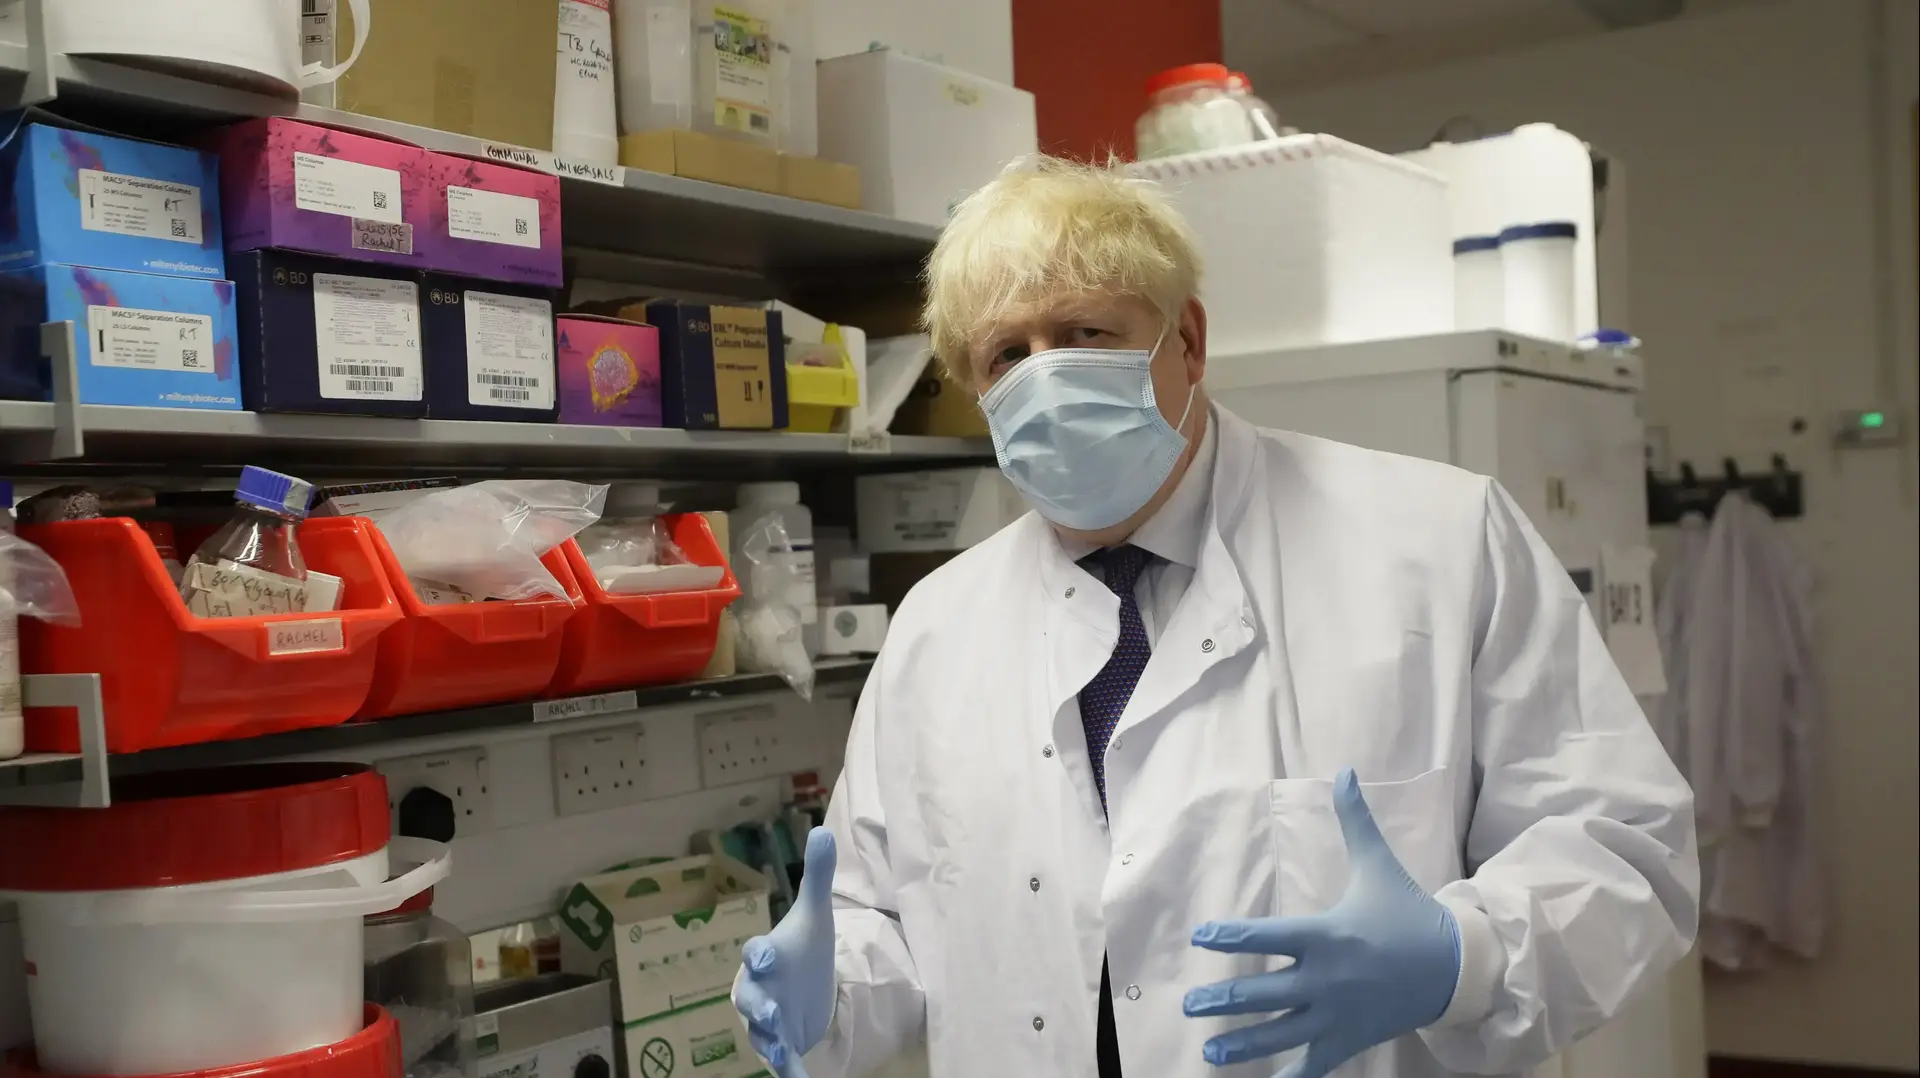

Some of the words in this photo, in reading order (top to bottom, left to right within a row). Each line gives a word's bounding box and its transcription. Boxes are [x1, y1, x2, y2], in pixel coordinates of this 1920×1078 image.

[486, 145, 539, 165] COMMUNAL
[553, 158, 615, 181] UNIVERSALS
[128, 180, 163, 191] Separation
[164, 185, 192, 195] Columns
[164, 198, 183, 213] RT
[289, 271, 308, 285] BD
[444, 291, 459, 304] BD
[137, 312, 174, 323] Separation
[174, 315, 203, 325] Columns
[179, 327, 198, 341] RT
[714, 337, 742, 349] Culture
[276, 631, 329, 648] RACHEL
[548, 701, 582, 717] RACHEL
